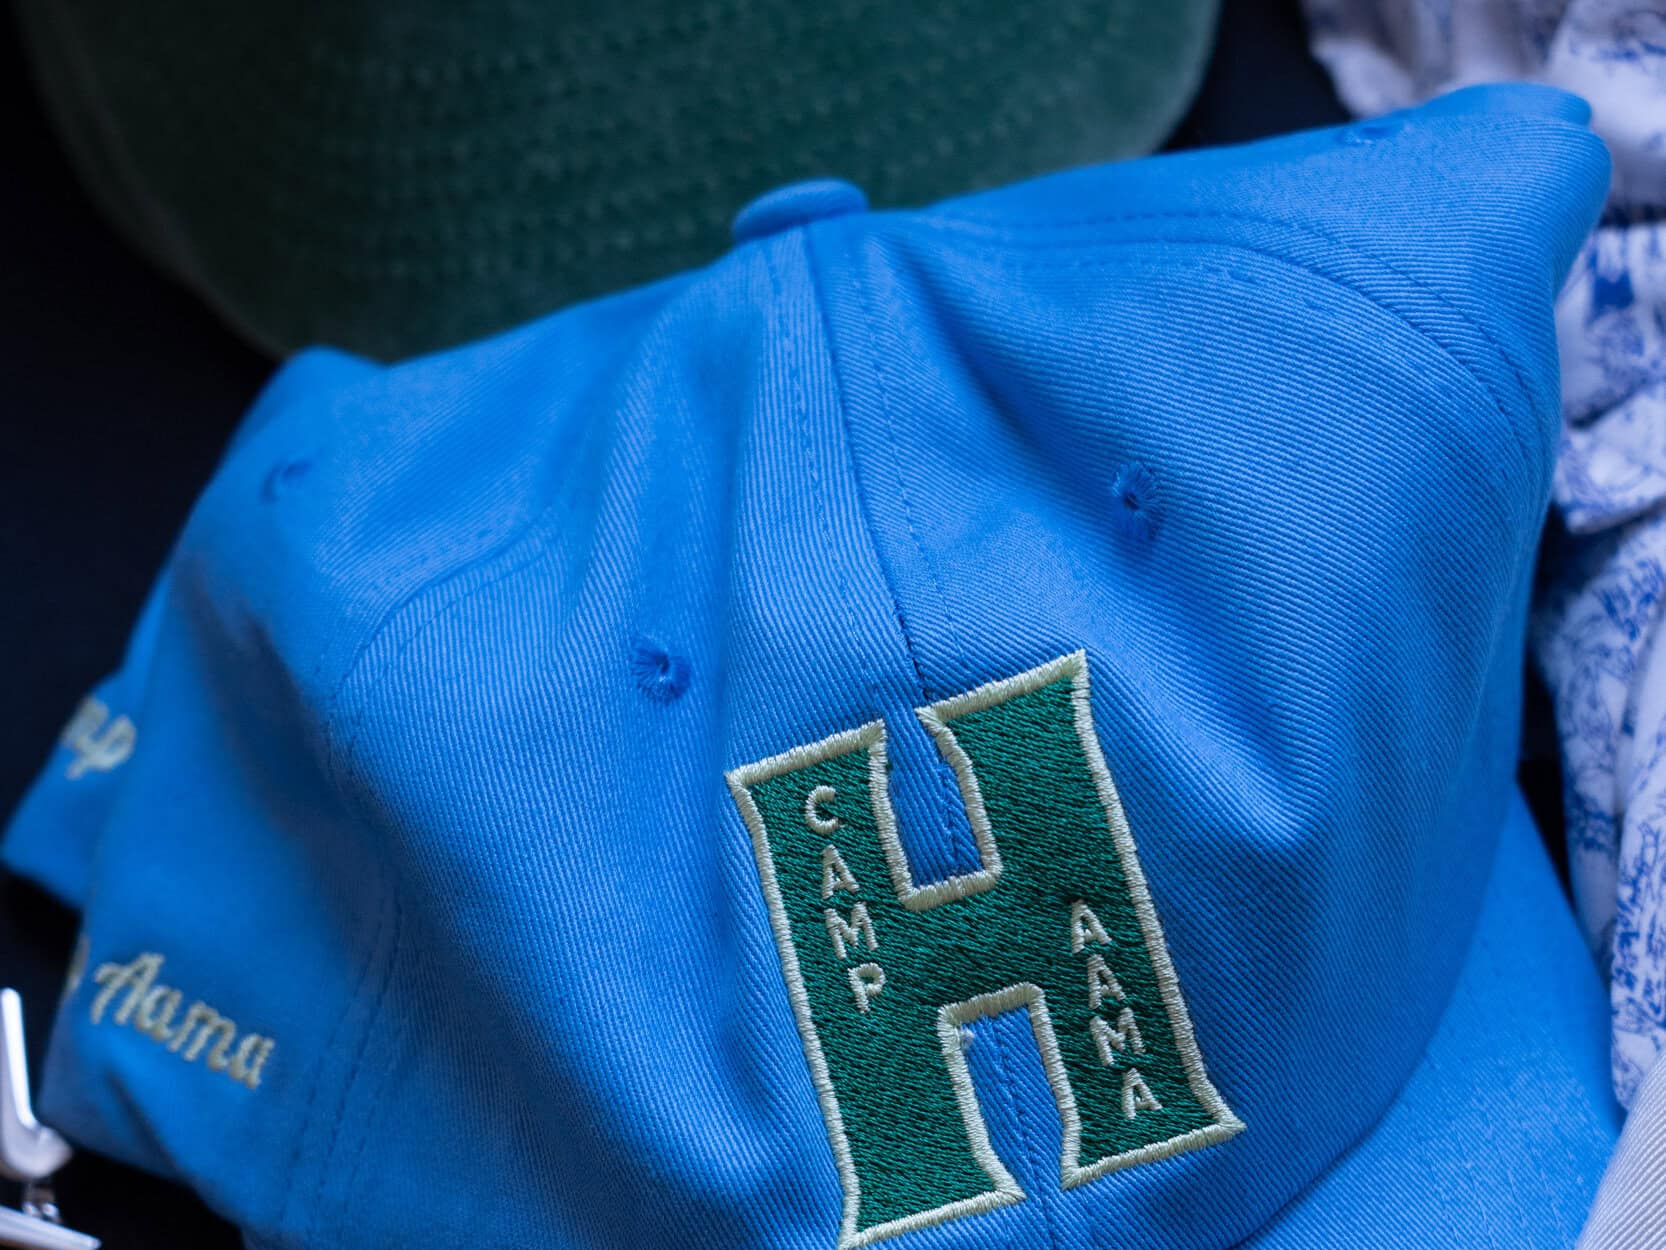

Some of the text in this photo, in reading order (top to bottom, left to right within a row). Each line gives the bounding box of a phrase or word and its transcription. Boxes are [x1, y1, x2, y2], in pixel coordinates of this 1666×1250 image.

[804, 785, 887, 1014] CAMP
[1070, 899, 1163, 1120] AAMA
[91, 951, 276, 1090] Aama
